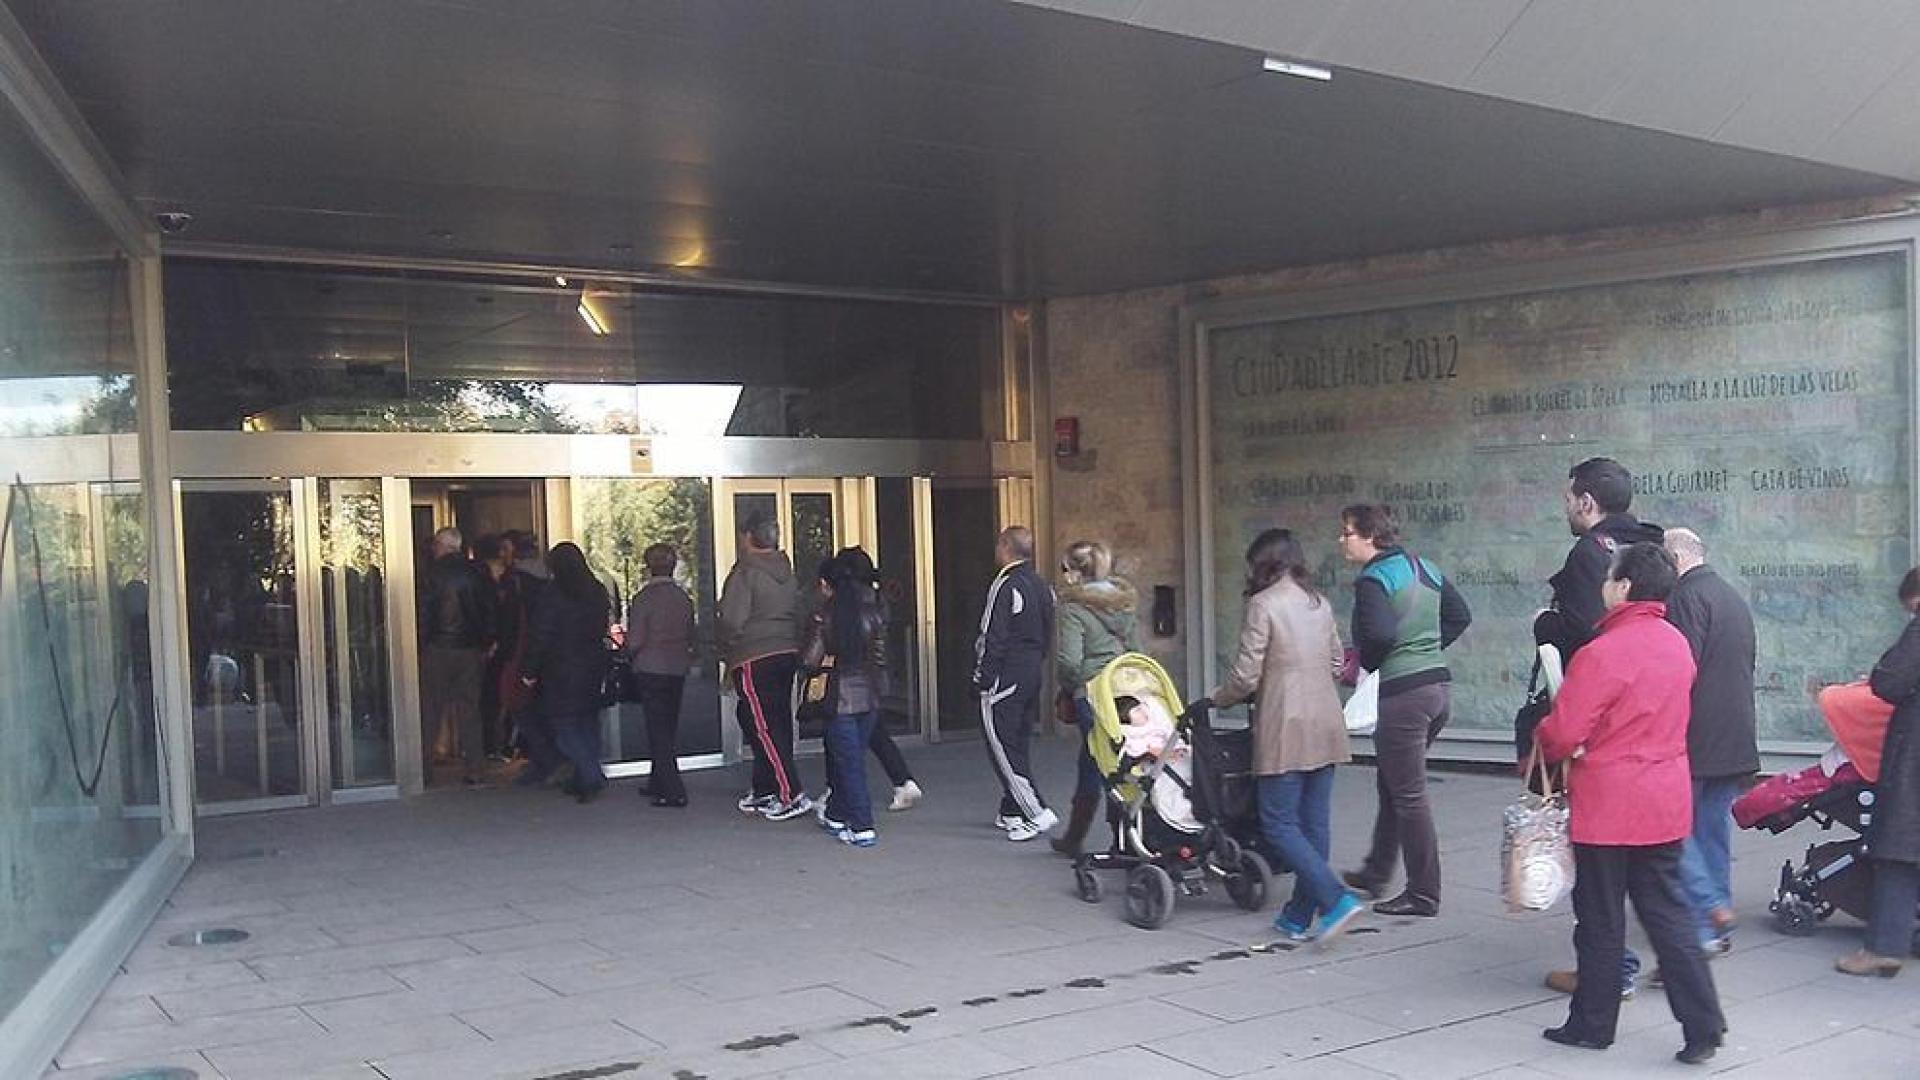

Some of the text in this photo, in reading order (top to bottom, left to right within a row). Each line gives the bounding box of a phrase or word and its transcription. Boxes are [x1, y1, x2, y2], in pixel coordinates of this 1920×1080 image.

[1402, 334, 1458, 382] 2012
[1723, 377, 1739, 400] LA
[1743, 374, 1766, 398] LUZ
[1770, 373, 1785, 396] DE
[1789, 370, 1816, 396] LAS
[1819, 368, 1858, 393] VELAS
[1632, 468, 1729, 496] DELA GOURMET
[1750, 465, 1850, 492] CATA DE VINOS
